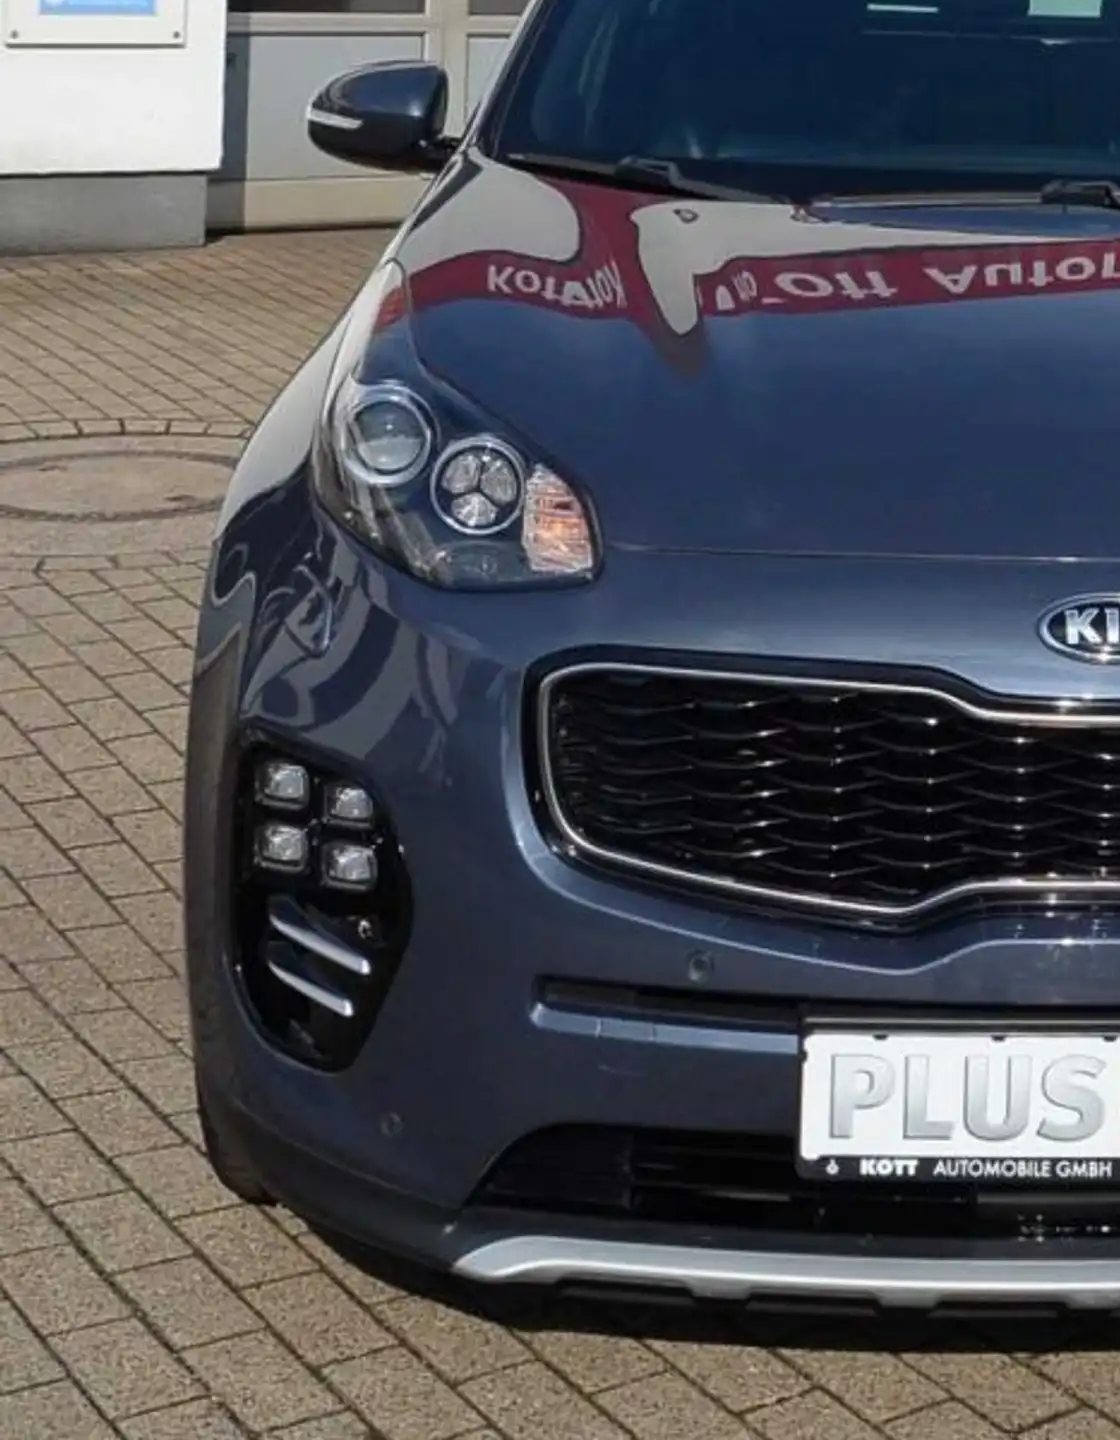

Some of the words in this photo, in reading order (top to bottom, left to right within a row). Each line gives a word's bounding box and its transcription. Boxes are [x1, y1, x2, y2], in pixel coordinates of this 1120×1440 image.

[859, 1158, 919, 1177] KOTT
[933, 1158, 1051, 1178] AUTOMOBILE
[1055, 1159, 1113, 1178] GMBH
